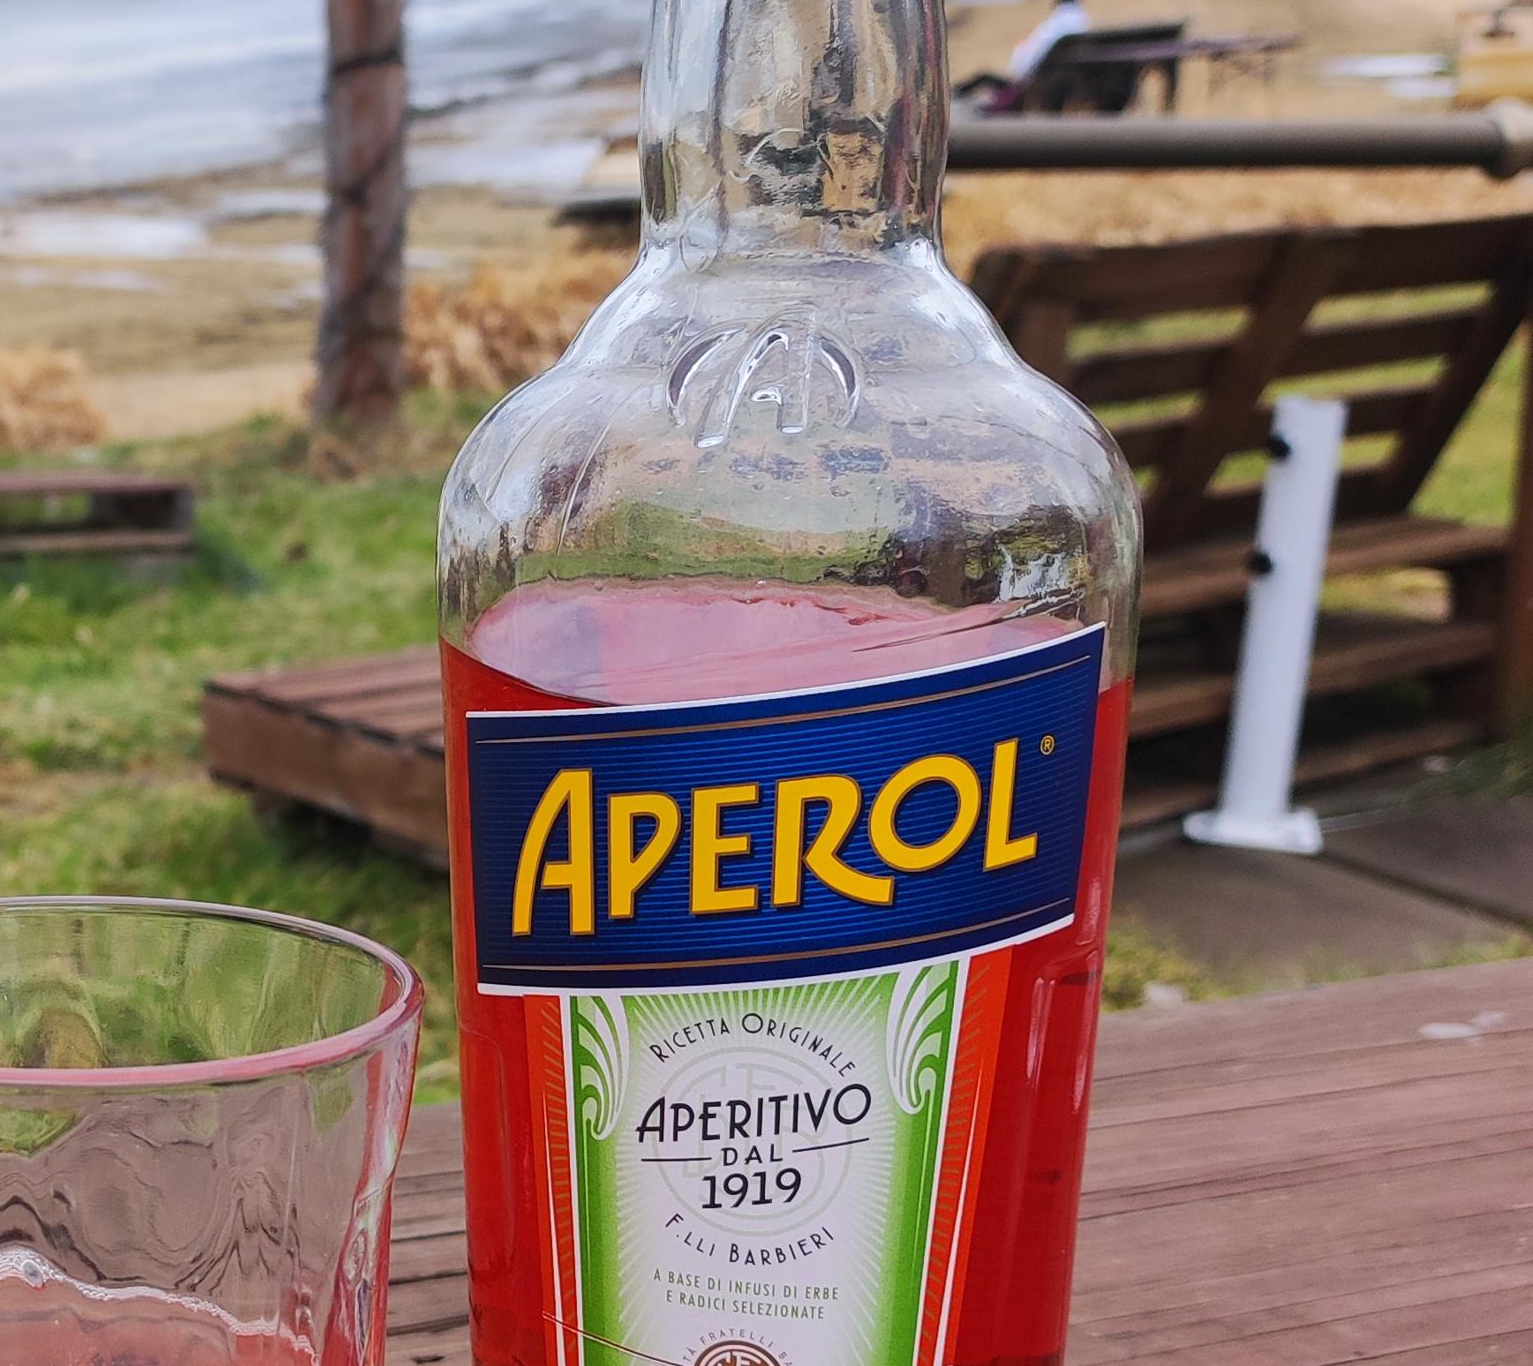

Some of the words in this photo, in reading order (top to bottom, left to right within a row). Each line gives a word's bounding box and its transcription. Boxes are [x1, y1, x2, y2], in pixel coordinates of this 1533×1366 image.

[511, 736, 1039, 937] APEROL
[649, 1017, 731, 1064] RICETTA
[741, 1012, 856, 1077] ORIGINALE
[636, 1083, 872, 1143] APERITIVO
[720, 1143, 784, 1167] DAL
[701, 1167, 802, 1209] 1919
[665, 1213, 716, 1257] F.LLI
[729, 1226, 835, 1266] BARBIERI
[653, 1268, 661, 1282] A
[668, 1271, 701, 1288] BASE
[707, 1277, 721, 1291] DI
[729, 1280, 776, 1298] INFUSI
[783, 1285, 798, 1299] DI
[805, 1286, 839, 1301] ERBE
[666, 1290, 673, 1303] E
[679, 1291, 726, 1312] RADICI
[732, 1300, 825, 1320] SELEZIONATE
[699, 1328, 774, 1348] FRATELLI
